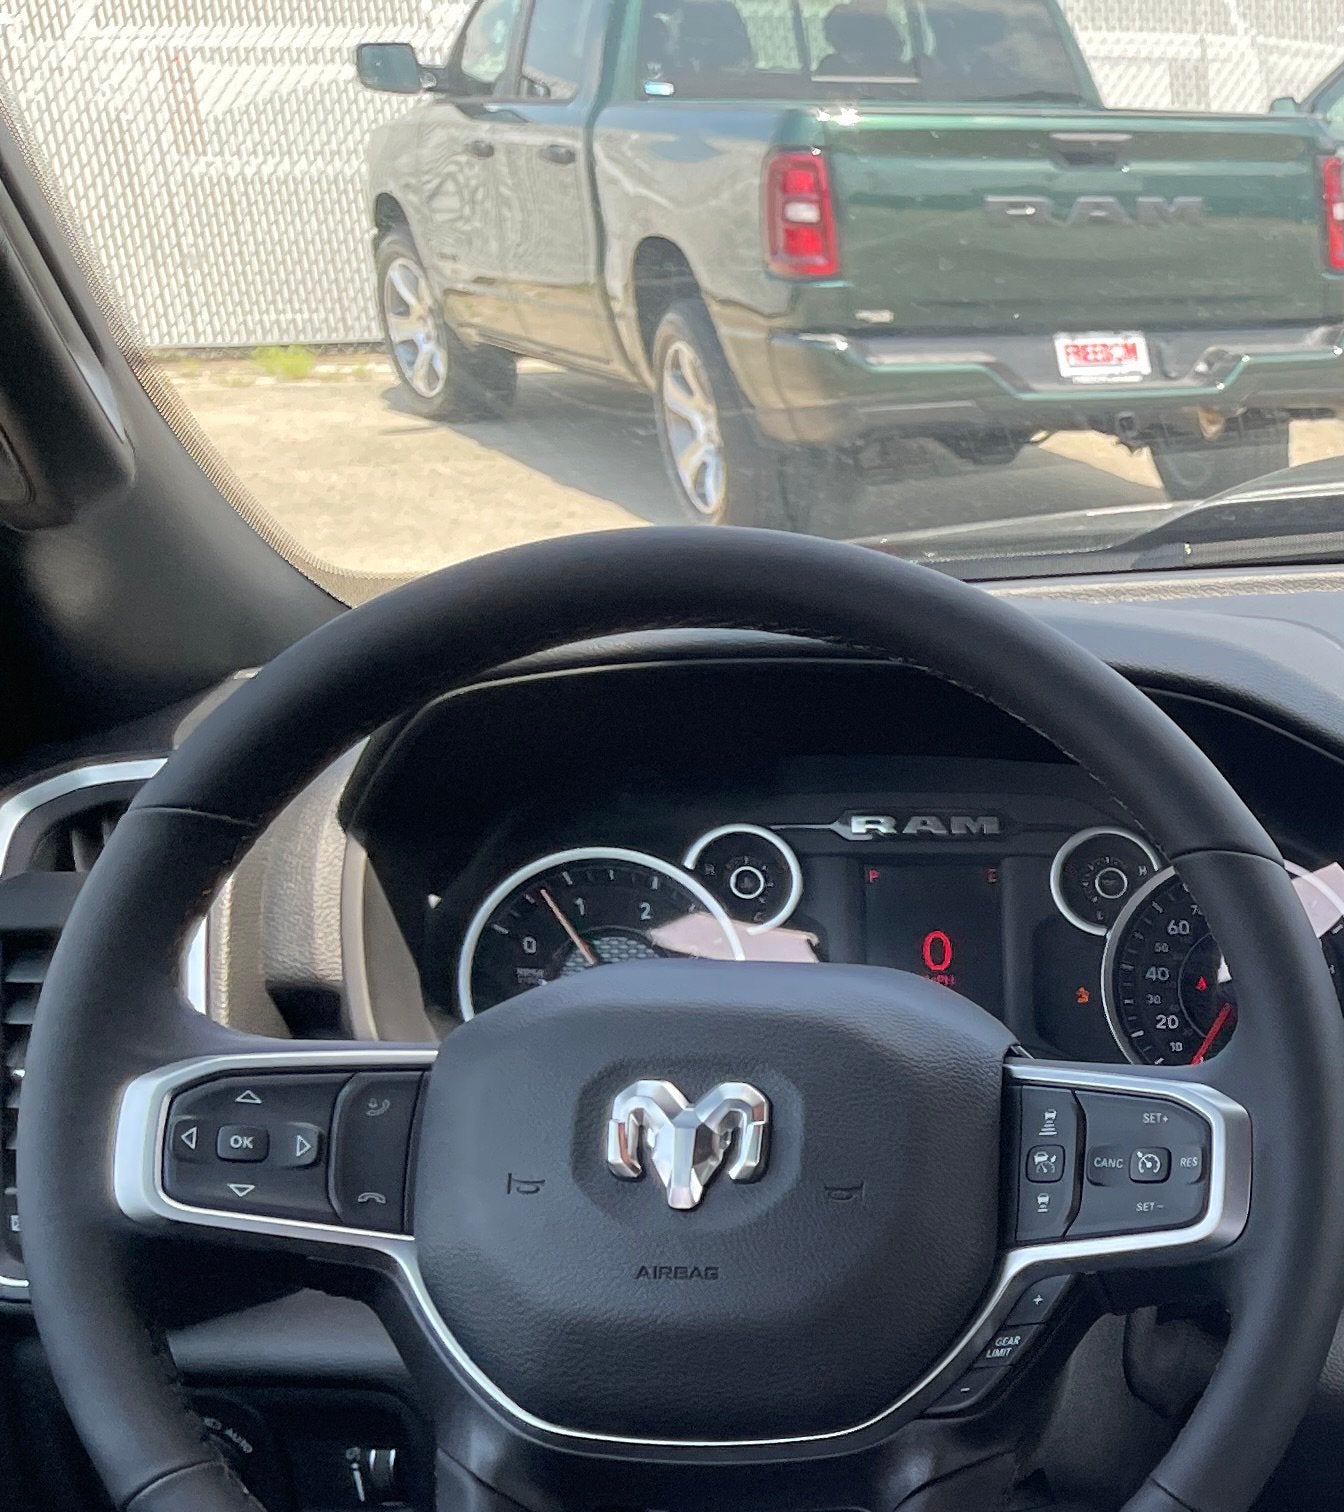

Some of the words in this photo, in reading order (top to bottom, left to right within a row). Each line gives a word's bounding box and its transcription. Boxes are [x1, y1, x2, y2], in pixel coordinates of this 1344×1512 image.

[985, 195, 1203, 225] RAM
[851, 815, 1000, 834] RAM
[574, 897, 585, 916] 1
[640, 901, 652, 921] 2
[1167, 919, 1191, 936] 60
[522, 935, 537, 954] 0
[922, 930, 953, 971] 0
[1144, 966, 1170, 982] 40
[1146, 993, 1162, 1005] 30
[1155, 1014, 1179, 1030] 20
[1169, 1041, 1183, 1053] 10
[1142, 1112, 1170, 1125] SET+
[230, 1135, 254, 1150] OK
[1093, 1156, 1124, 1170] CANC
[1179, 1155, 1199, 1168] RES
[635, 1265, 720, 1281] AIRBAG
[995, 1335, 1022, 1347] GEAR
[985, 1347, 1013, 1359] LIMIT
